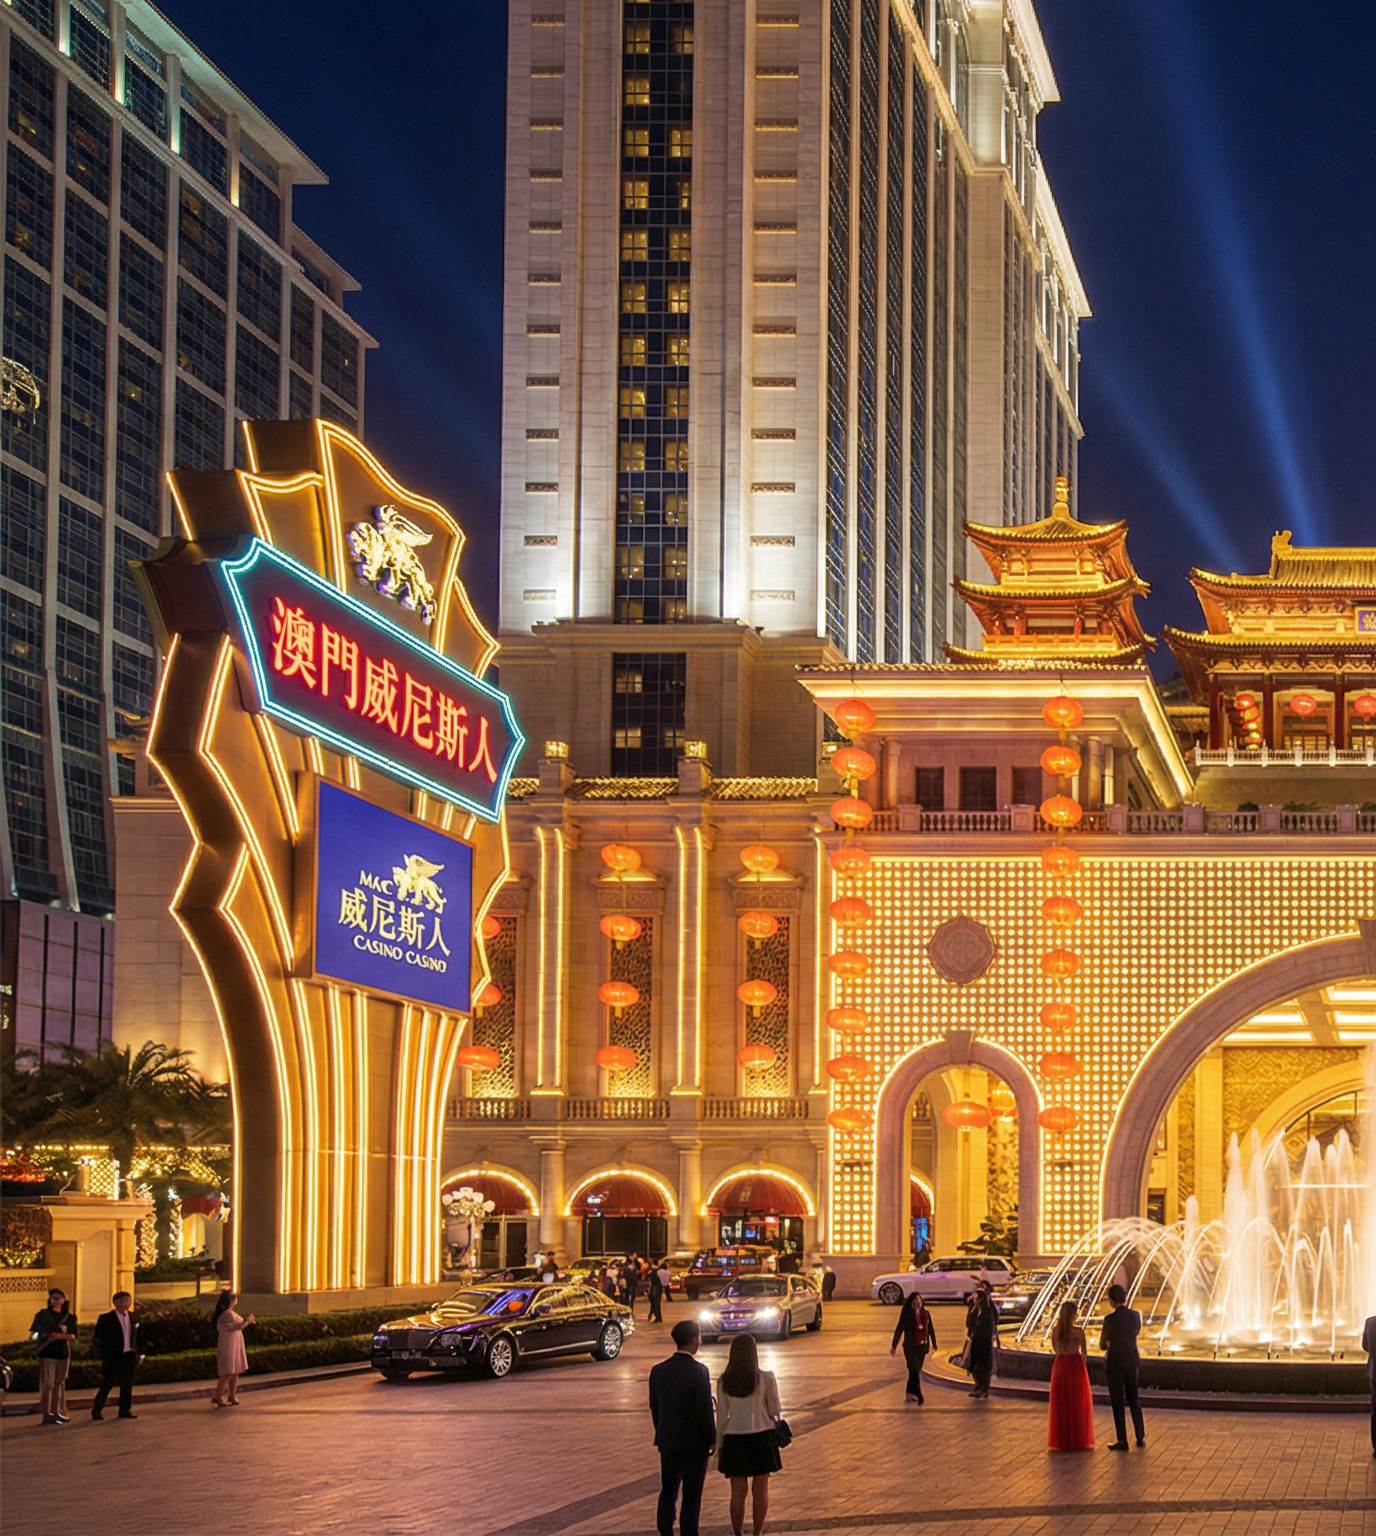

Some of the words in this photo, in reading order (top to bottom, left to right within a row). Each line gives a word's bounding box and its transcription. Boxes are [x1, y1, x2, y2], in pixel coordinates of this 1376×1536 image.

[272, 596, 498, 783] 澳門威尼斯人
[358, 869, 394, 895] MAC
[337, 887, 451, 957] 威尼斯人
[353, 934, 404, 961] CASINO
[405, 950, 448, 973] CASINO
